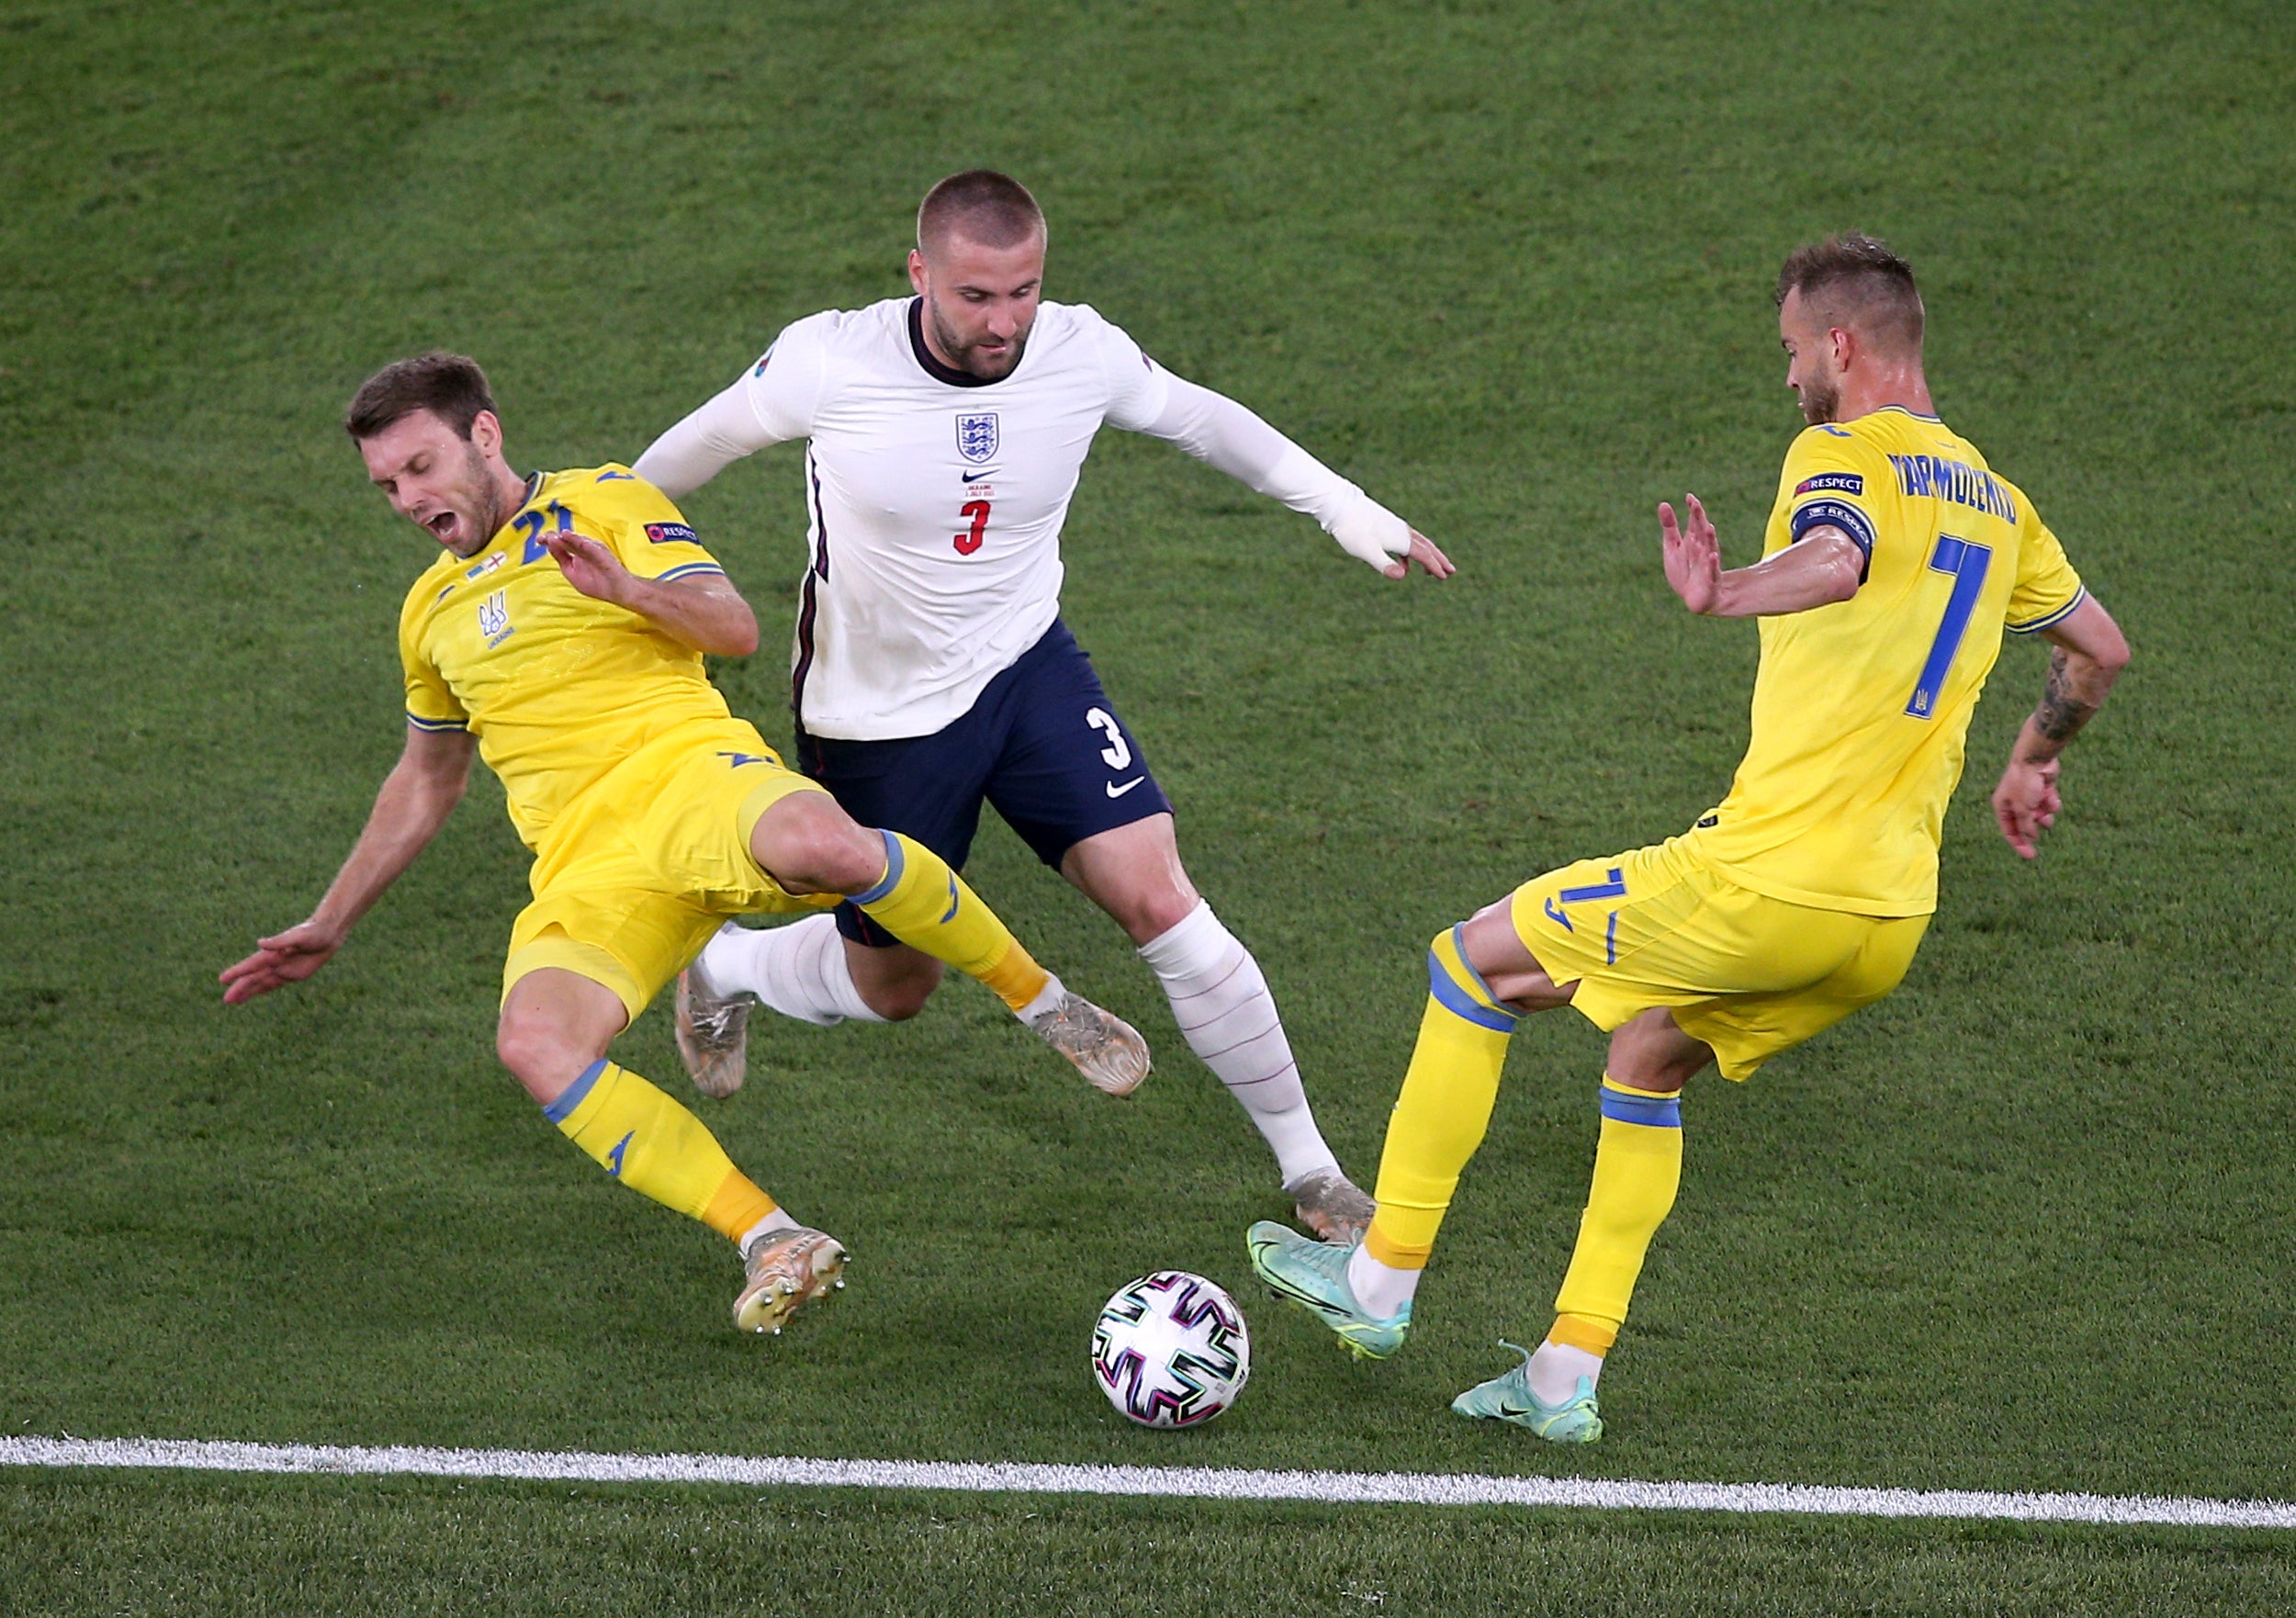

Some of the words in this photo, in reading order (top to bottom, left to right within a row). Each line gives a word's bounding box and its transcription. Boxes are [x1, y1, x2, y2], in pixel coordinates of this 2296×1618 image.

[1810, 478, 1862, 490] RESPECT
[953, 499, 991, 556] 3
[1828, 506, 1870, 544] RESPC
[1903, 532, 1994, 721] 7
[1086, 706, 1132, 770] 3
[1559, 868, 1627, 904] 7
